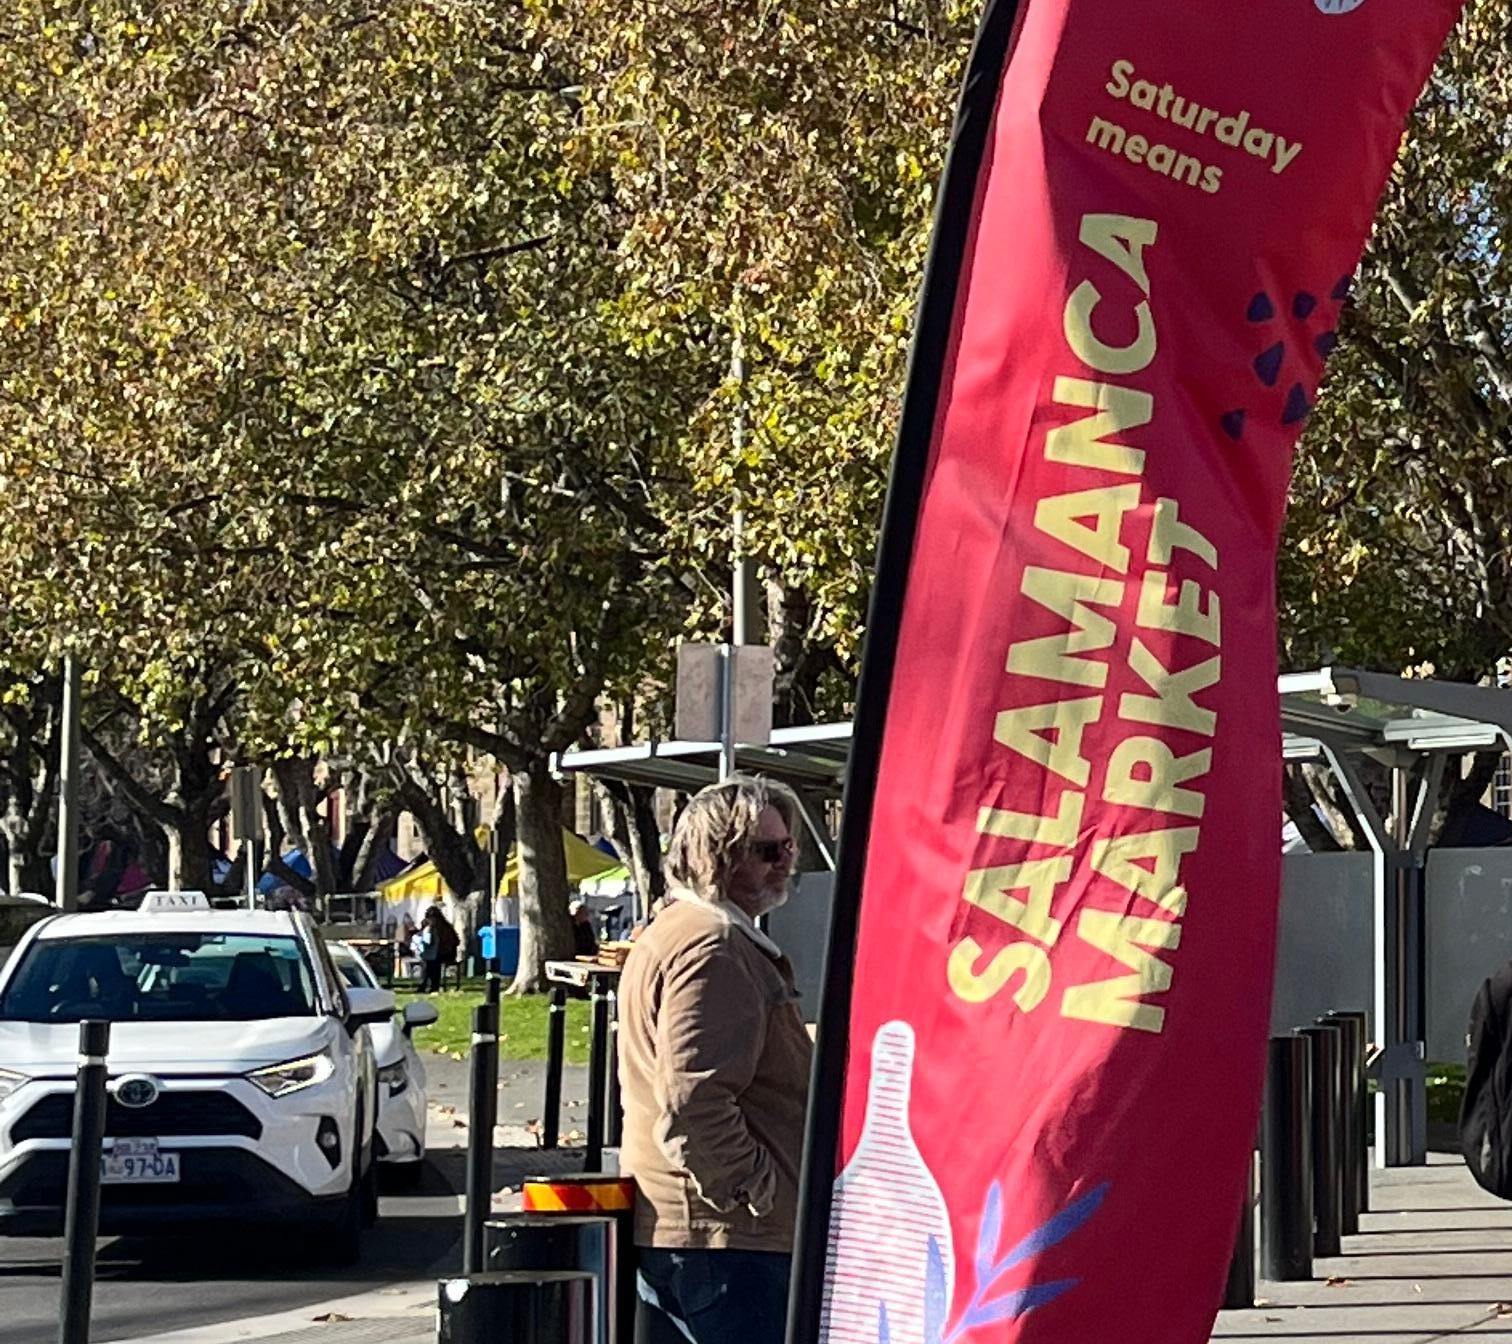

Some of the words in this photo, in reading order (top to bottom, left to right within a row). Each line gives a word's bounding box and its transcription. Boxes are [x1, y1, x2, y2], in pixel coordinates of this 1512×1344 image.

[1085, 116, 1224, 194] means
[1105, 59, 1302, 175] Saturday
[947, 213, 1158, 1014] SALAMANCA
[1060, 497, 1221, 1034] MARKET
[156, 895, 197, 906] TAXI
